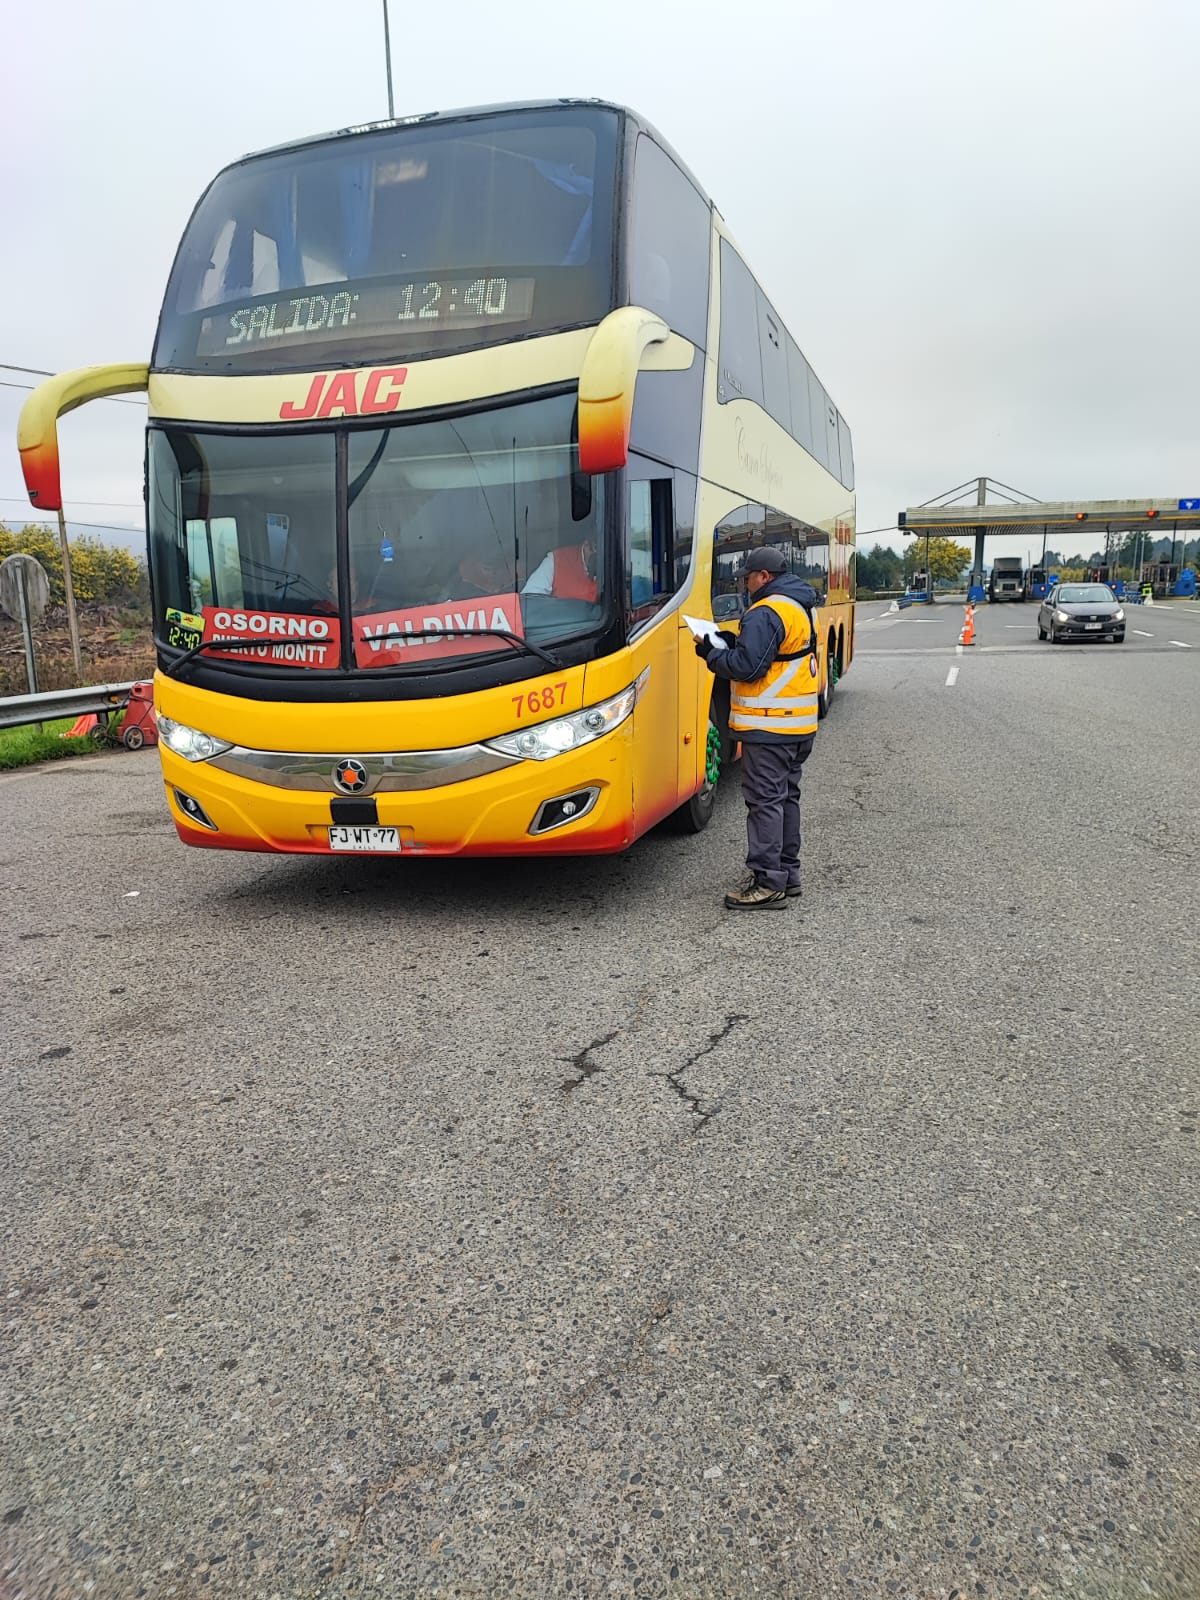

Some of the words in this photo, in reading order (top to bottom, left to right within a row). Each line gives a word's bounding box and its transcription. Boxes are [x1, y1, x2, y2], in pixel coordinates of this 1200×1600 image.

[225, 290, 360, 345] SALIDA:
[398, 277, 508, 320] 12:40
[279, 367, 407, 419] JAC
[168, 626, 201, 650] 12:40
[213, 612, 328, 638] OSORNO
[362, 607, 512, 651] VALDIVIA
[271, 642, 328, 664] MONTT
[511, 681, 568, 718] 7687
